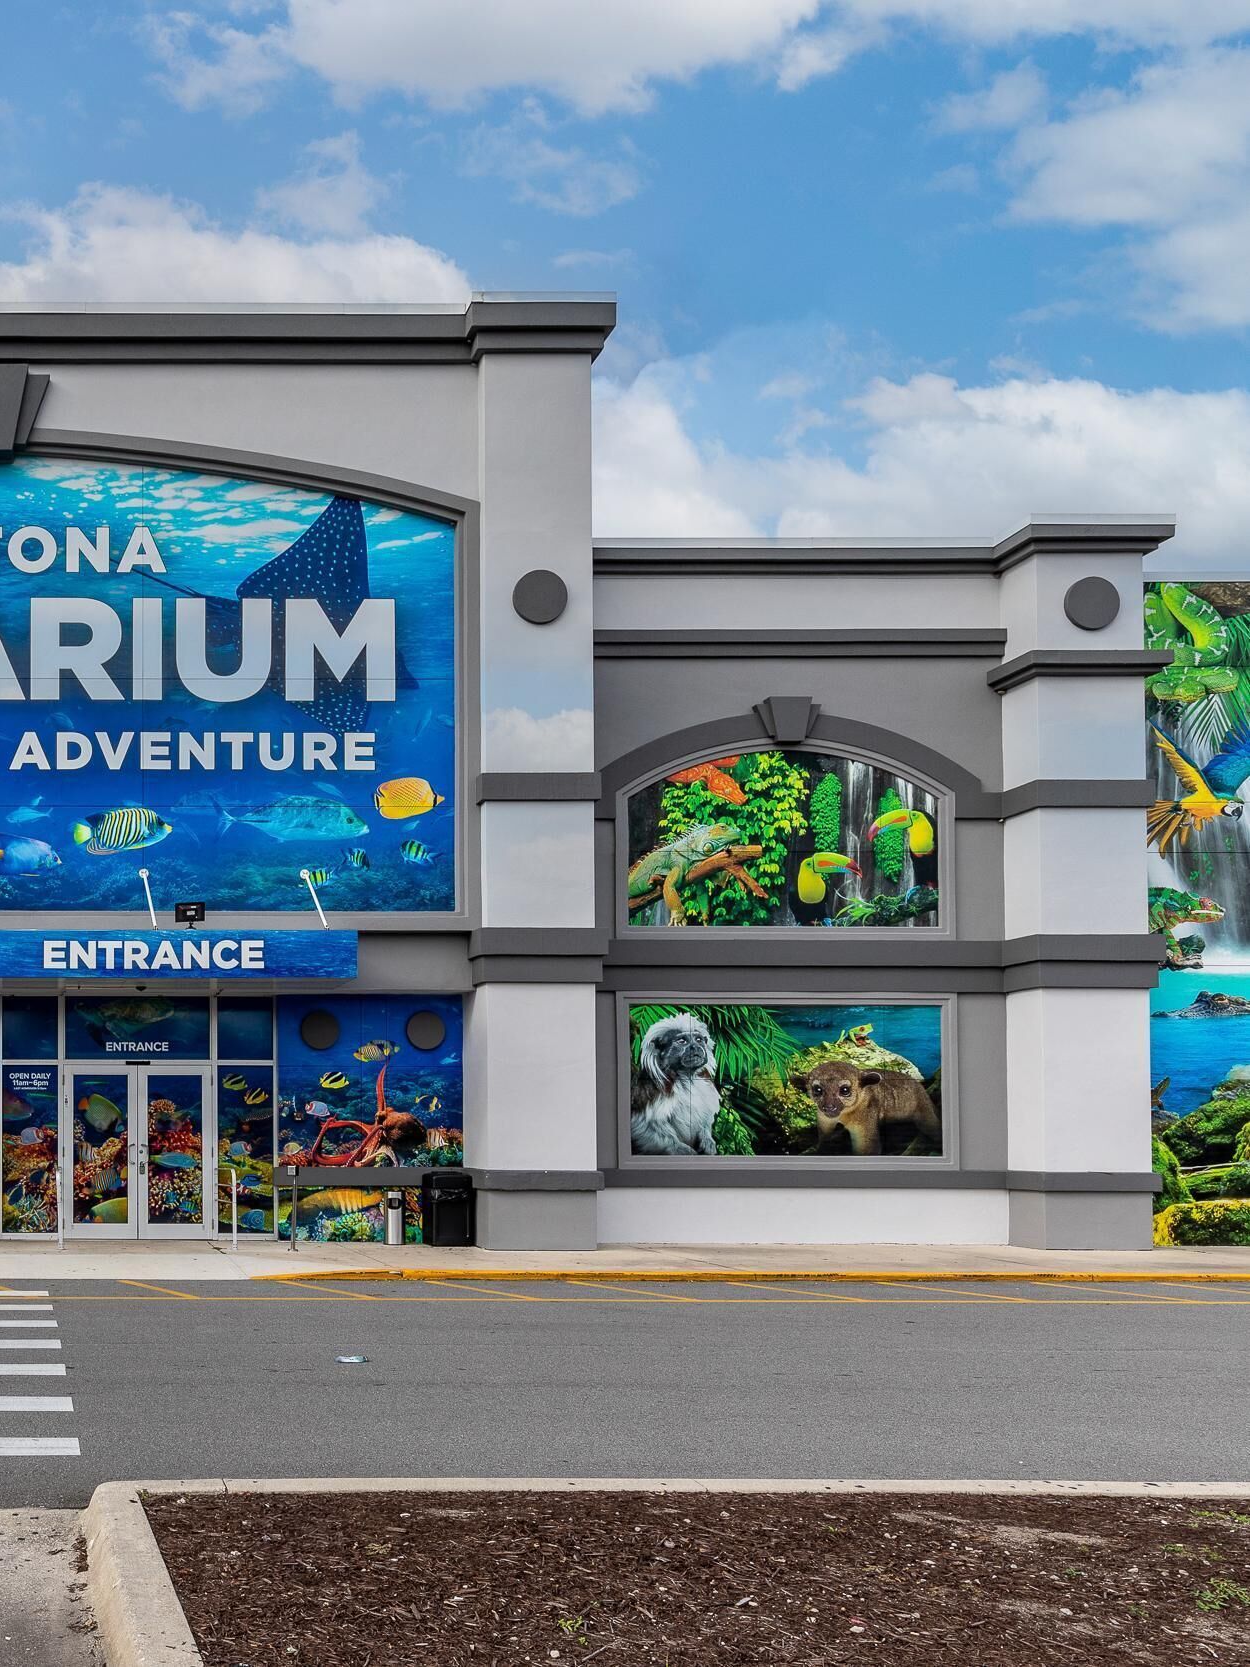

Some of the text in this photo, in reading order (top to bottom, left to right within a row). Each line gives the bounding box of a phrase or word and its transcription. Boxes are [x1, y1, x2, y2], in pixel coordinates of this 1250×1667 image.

[10, 731, 376, 771] ADVENTURE
[43, 939, 265, 969] ENTRANCE
[105, 1041, 169, 1052] ENTRANCE
[9, 1072, 52, 1080] OPEN DAILY
